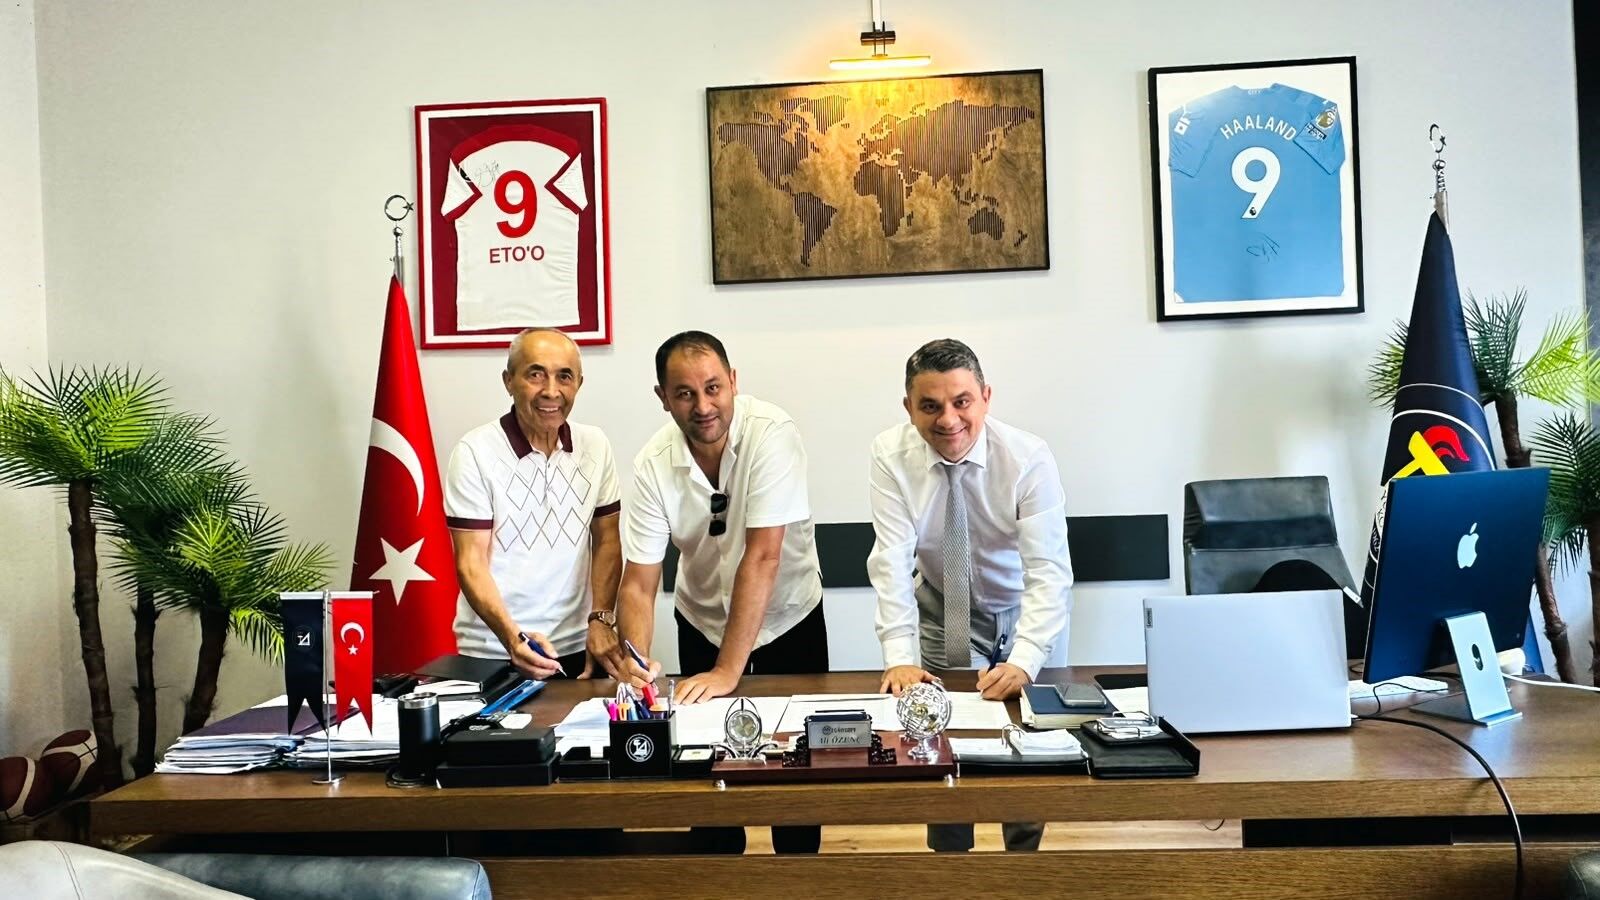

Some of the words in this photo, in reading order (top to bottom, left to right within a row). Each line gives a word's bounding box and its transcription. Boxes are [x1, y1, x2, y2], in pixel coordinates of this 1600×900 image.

[1220, 115, 1297, 140] HAALAND
[494, 170, 537, 238] 9
[1231, 146, 1281, 219] 9
[489, 245, 545, 263] ETO'O
